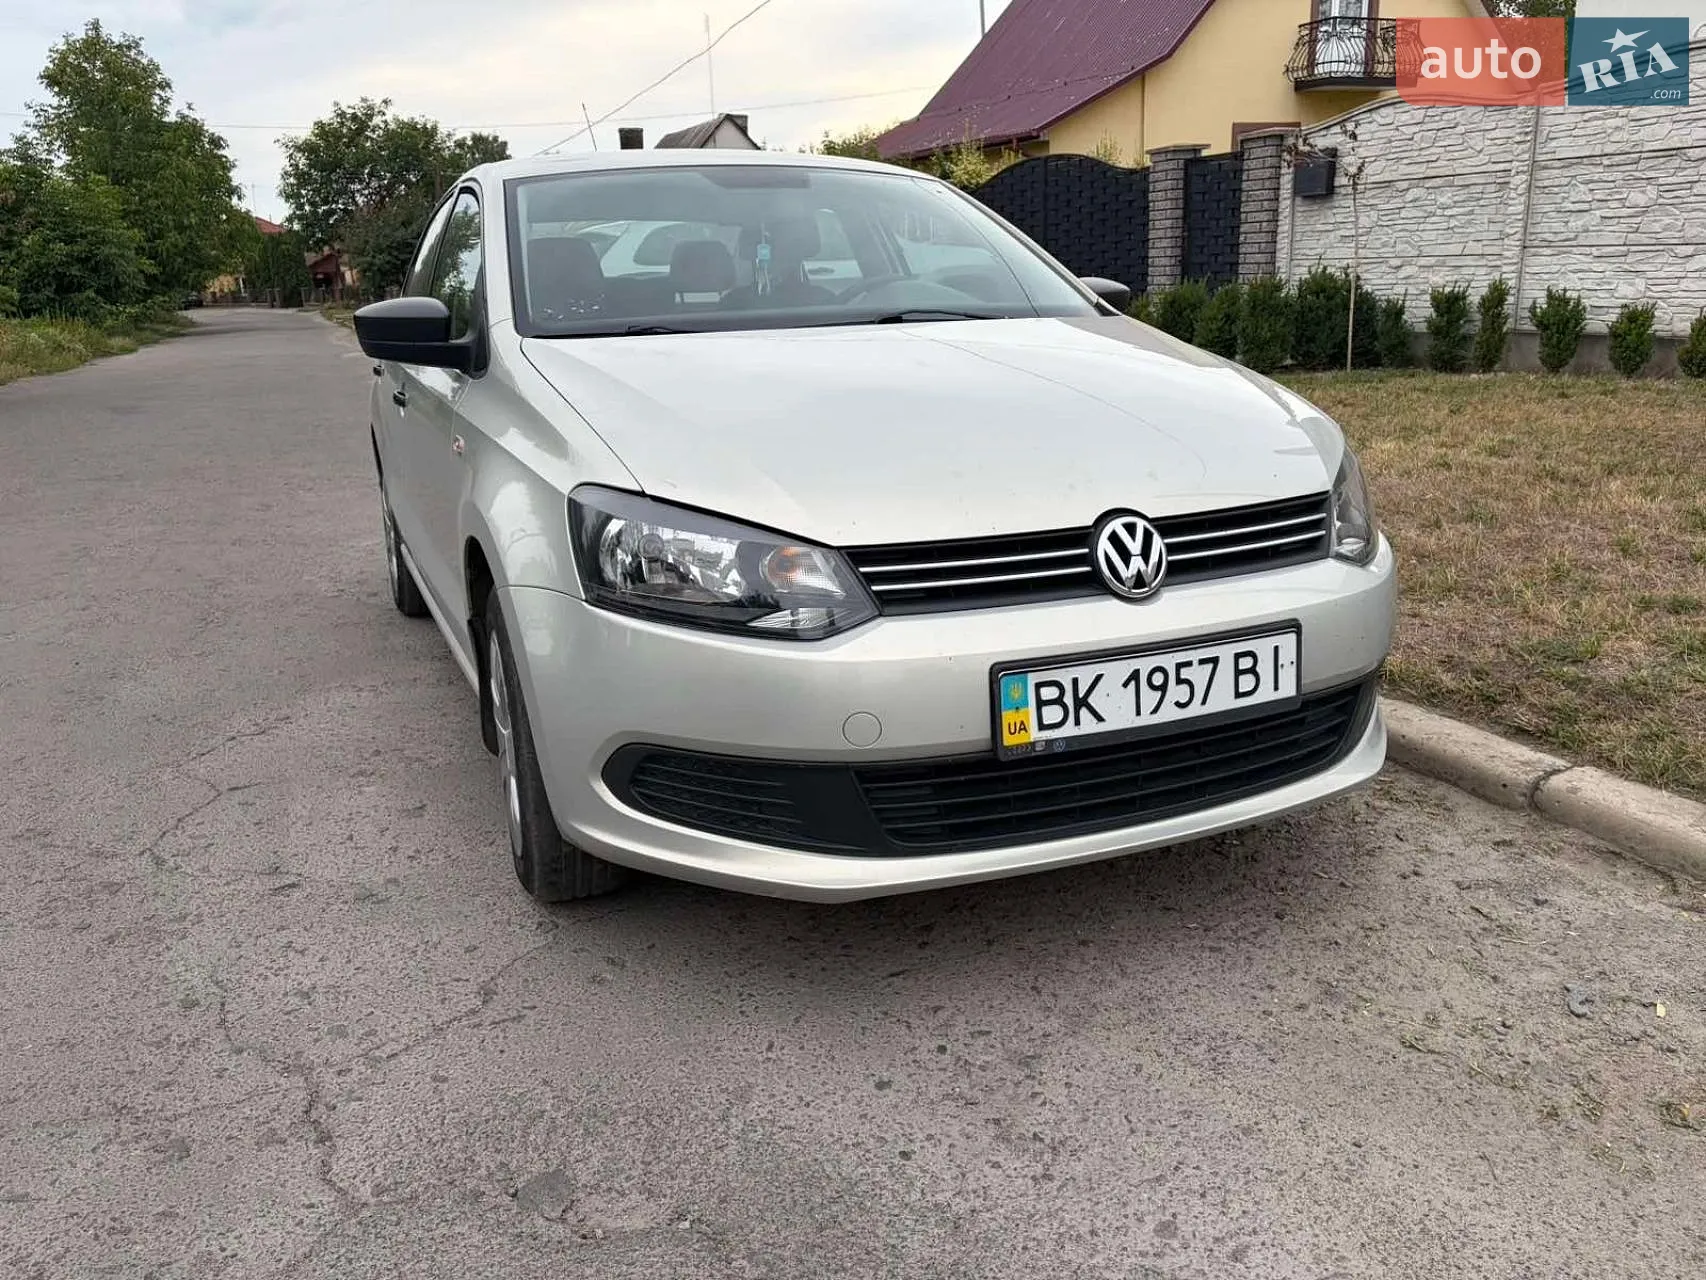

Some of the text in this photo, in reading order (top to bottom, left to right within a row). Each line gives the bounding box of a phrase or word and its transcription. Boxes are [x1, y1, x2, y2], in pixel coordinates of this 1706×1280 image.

[1034, 644, 1280, 731] BK 1957 BI
[1008, 720, 1028, 735] UA
